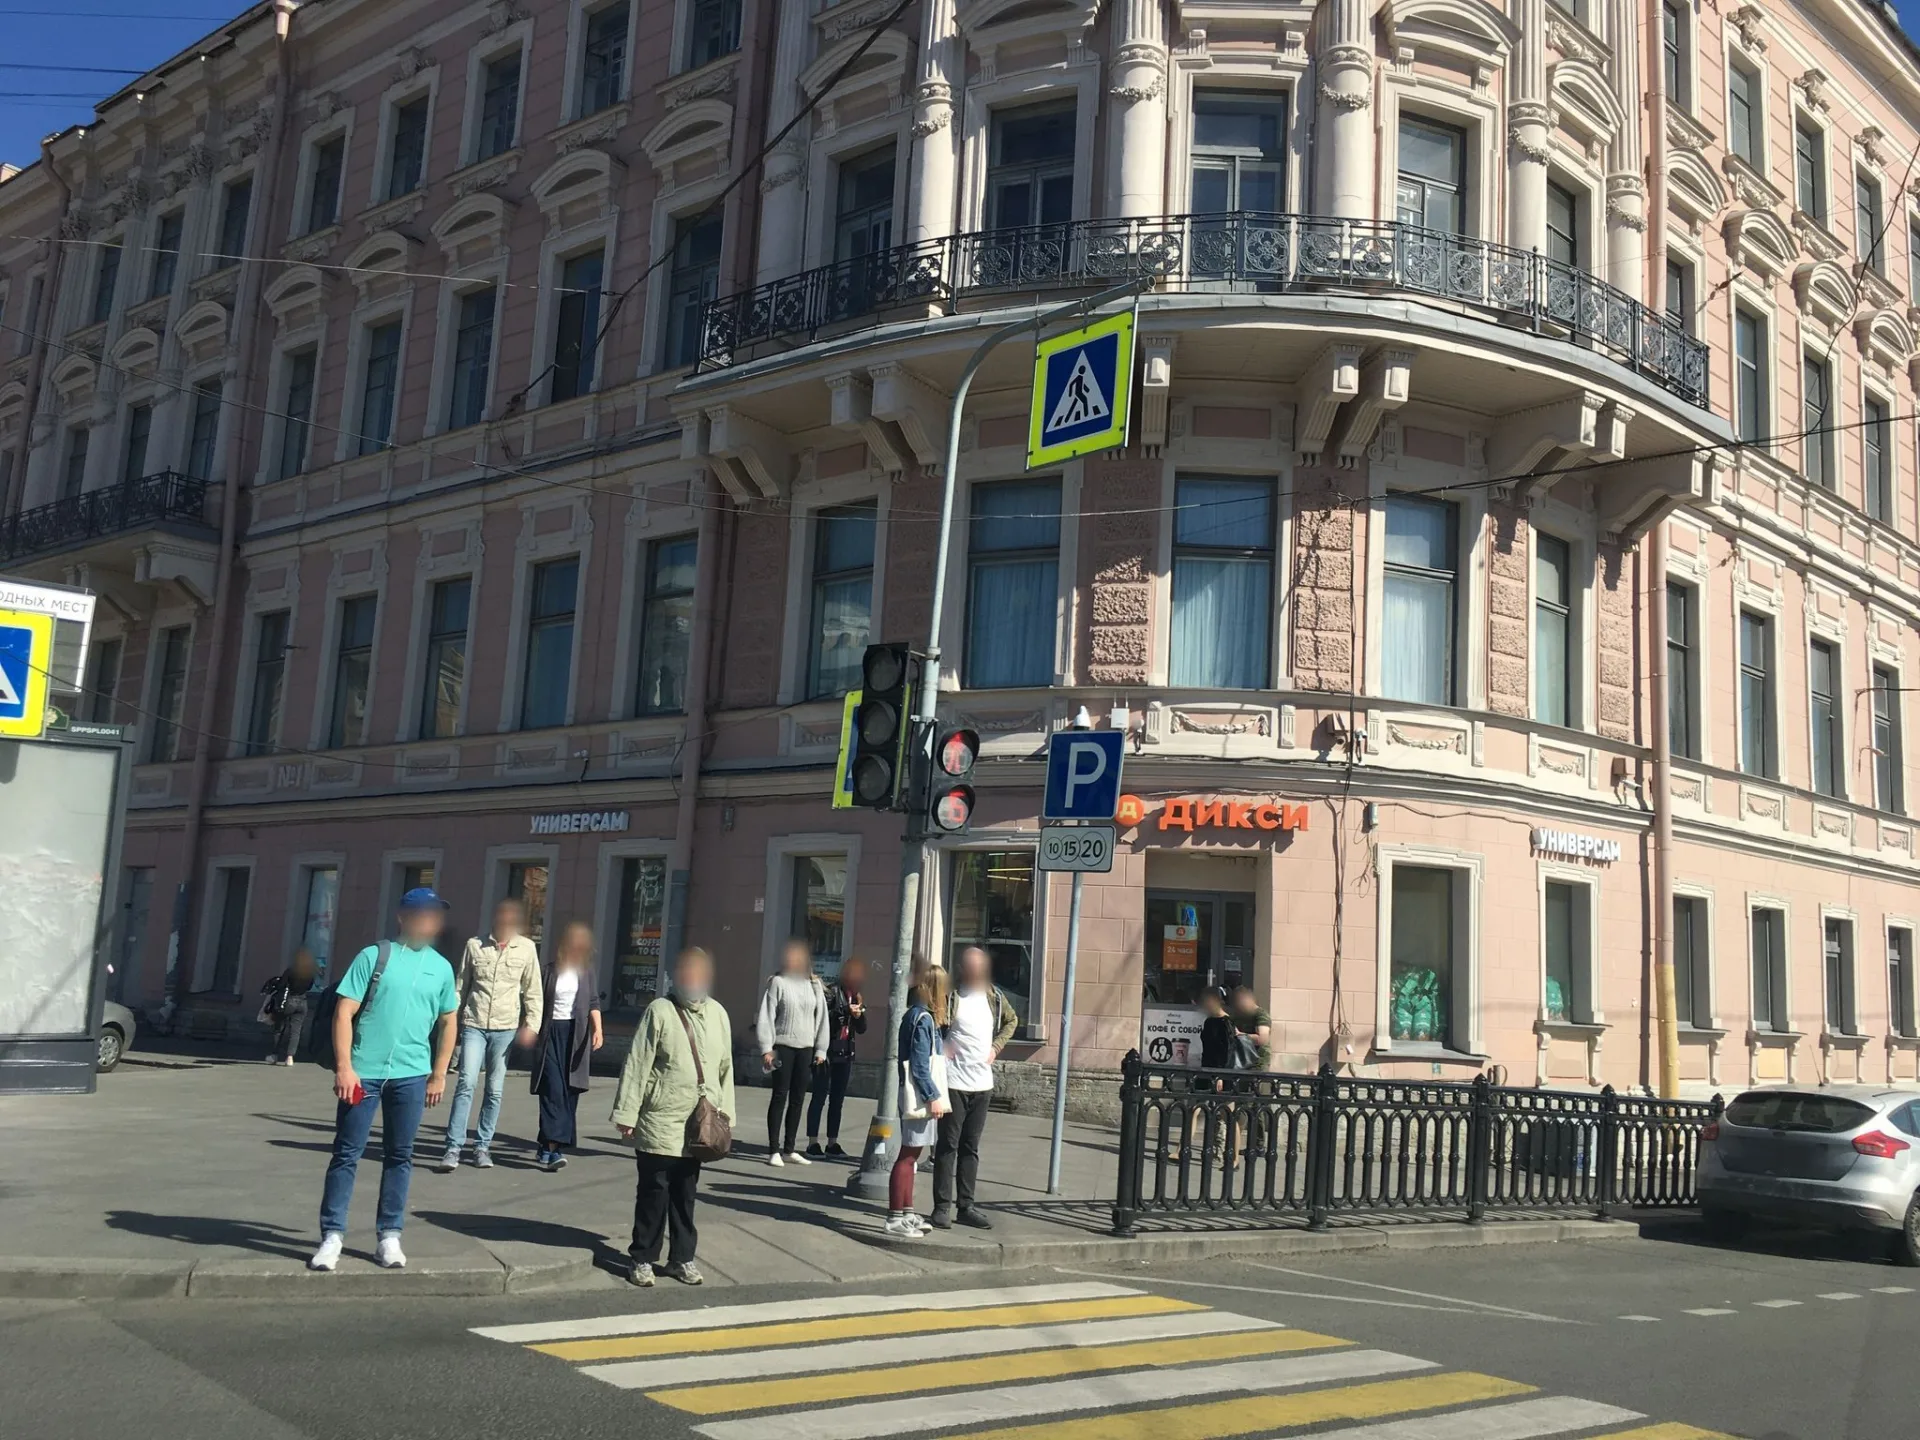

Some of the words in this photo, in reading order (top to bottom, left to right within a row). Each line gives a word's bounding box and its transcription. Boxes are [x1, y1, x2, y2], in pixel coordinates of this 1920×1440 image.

[51, 599, 88, 614] МЕСТ
[1064, 742, 1107, 809] P
[530, 812, 626, 834] УНИВЕРСАМ
[1119, 802, 1137, 818] Д
[1159, 799, 1309, 831] ДИКСИ
[1049, 842, 1059, 854] 10
[1064, 841, 1077, 856] 15
[1081, 840, 1102, 858] 20
[1539, 828, 1621, 861] УНИВЕРСАМ
[639, 947, 649, 955] TO
[1167, 946, 1176, 954] 24
[1178, 1025, 1203, 1034] СОБОЙ
